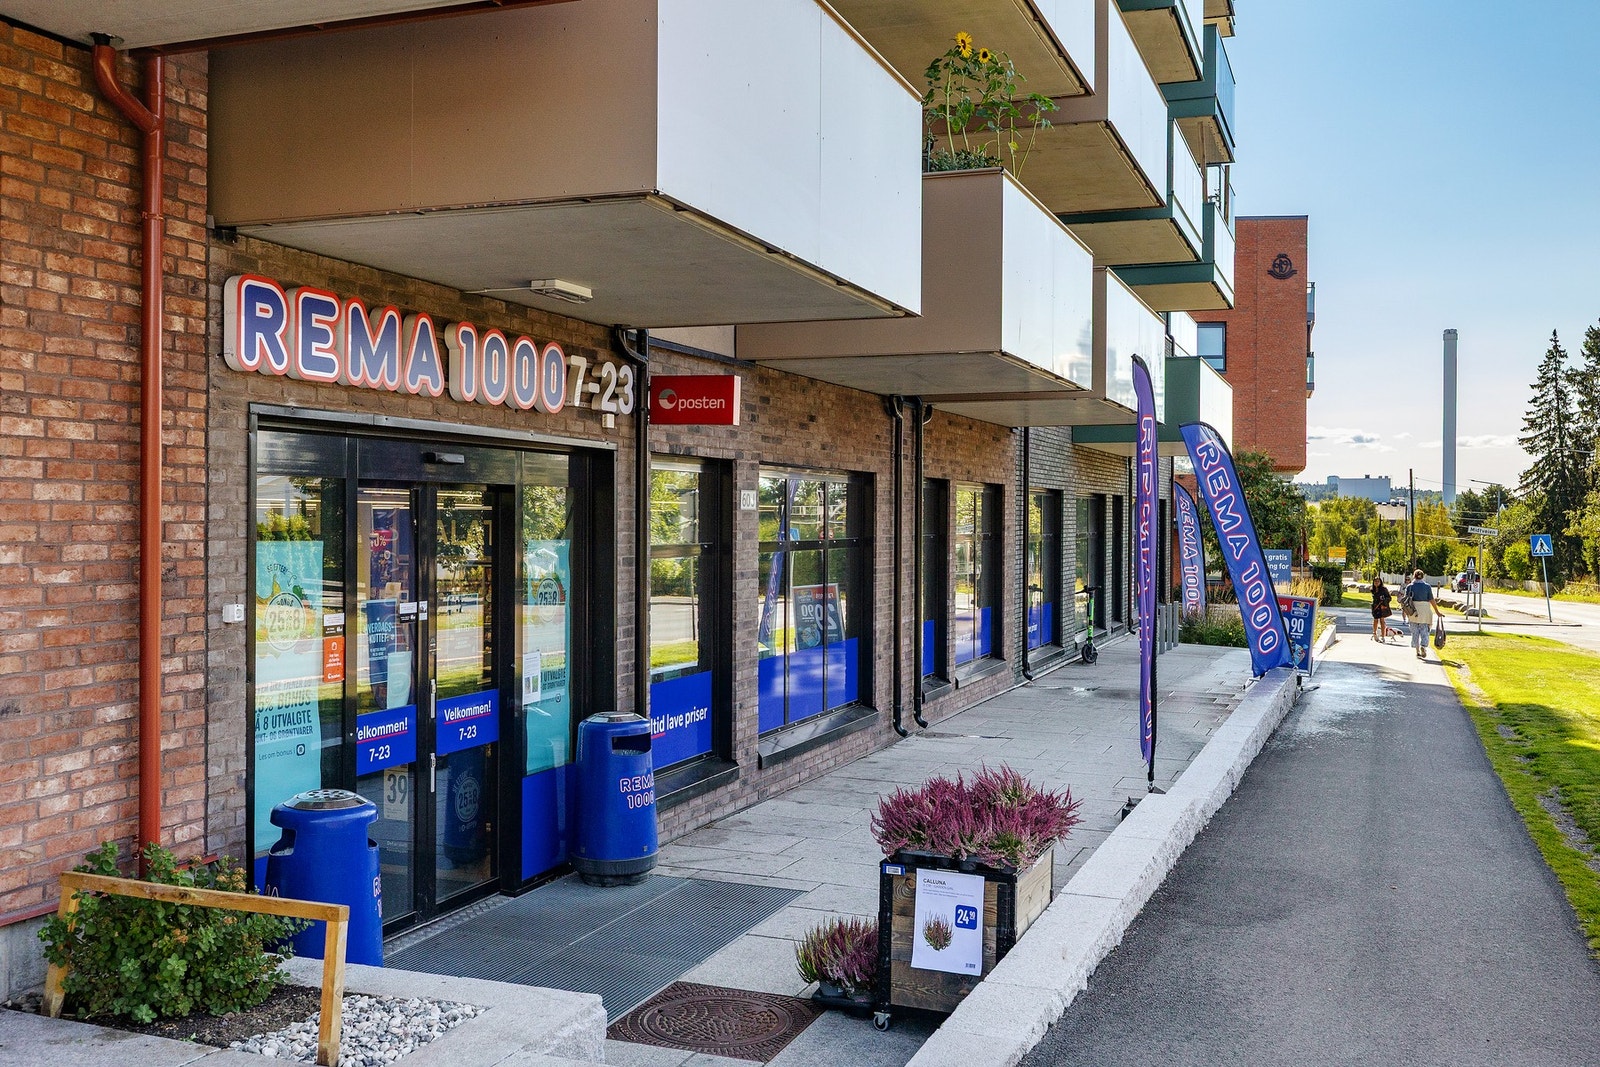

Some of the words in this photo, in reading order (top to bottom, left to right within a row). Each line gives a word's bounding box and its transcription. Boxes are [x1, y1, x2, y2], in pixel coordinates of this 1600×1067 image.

[231, 273, 444, 398] REMA
[450, 321, 567, 414] 1000
[567, 355, 634, 415] 7-23
[678, 396, 725, 411] posten
[741, 493, 756, 508] 60J
[1180, 496, 1198, 560] REMA
[1470, 526, 1496, 535] Midtveien
[1196, 440, 1250, 560] REMA
[1241, 562, 1279, 653] 1000
[1268, 553, 1288, 562] gratis
[1279, 562, 1289, 570] for
[1291, 617, 1305, 633] 90
[444, 700, 492, 721] Velkommen!
[666, 713, 684, 731] lave
[684, 706, 709, 728] priser
[263, 716, 269, 730] 8
[271, 709, 313, 729] UTVALGTE
[355, 717, 408, 740] elkommen!
[459, 725, 477, 741] 7-23
[258, 753, 268, 761] Les
[369, 745, 391, 762] 7-23
[386, 773, 409, 805] 39
[922, 878, 947, 886] CALLUNA
[956, 908, 970, 925] 24
